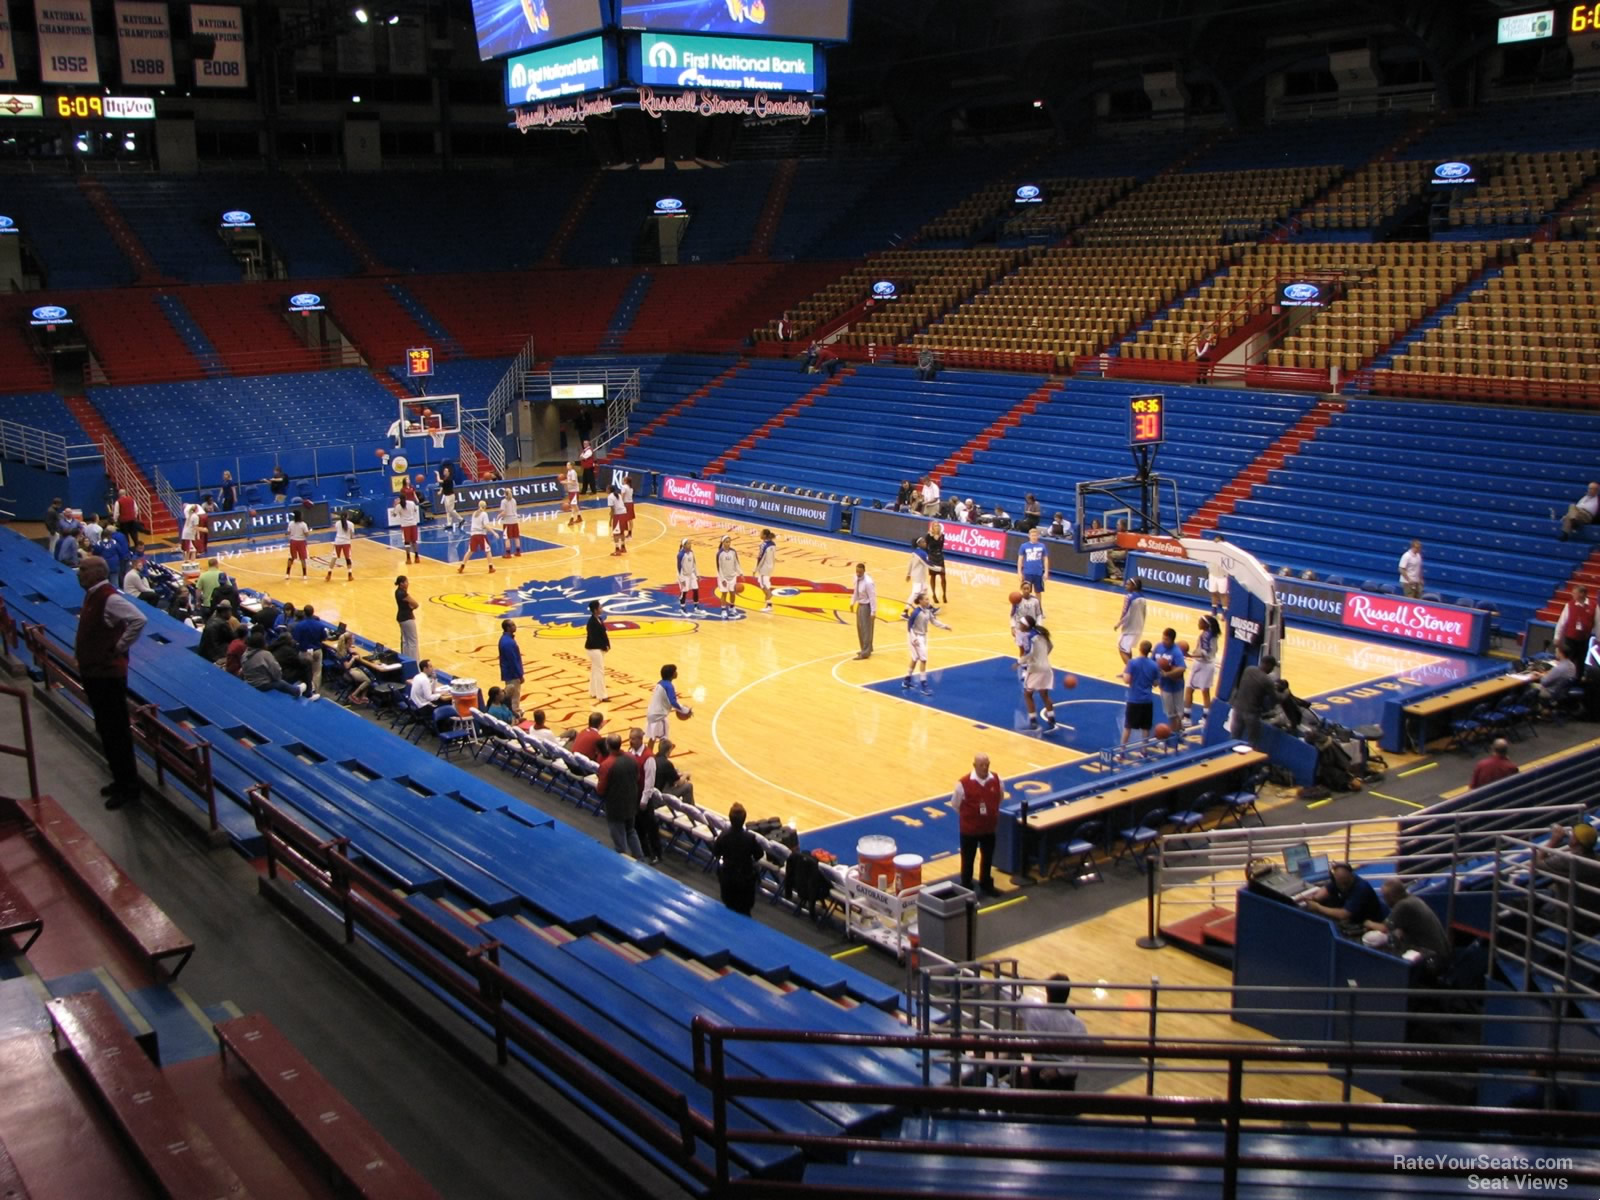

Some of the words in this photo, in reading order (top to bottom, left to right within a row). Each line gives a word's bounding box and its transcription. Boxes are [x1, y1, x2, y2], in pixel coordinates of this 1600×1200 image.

[42, 8, 88, 22] NATIONAL
[122, 15, 165, 26] NATIONAL
[198, 18, 239, 30] NATIONAL
[39, 23, 93, 36] CHAMPIONS
[119, 28, 170, 40] CHAMPIONS
[195, 32, 243, 43] MPIONS
[51, 55, 89, 73] 1952
[130, 58, 166, 75] 1988
[203, 60, 241, 77] 2008
[683, 52, 711, 69] First
[711, 53, 771, 73] National
[772, 57, 807, 75] Bank
[57, 96, 103, 117] 6:09
[576, 94, 612, 121] Candies
[637, 86, 698, 119] Russell
[699, 87, 753, 117] Stover
[754, 91, 812, 119] Candies
[410, 350, 430, 359] 49:36
[412, 358, 429, 373] 30
[1132, 399, 1159, 413] 49:36
[1135, 414, 1158, 440] 30
[469, 488, 506, 501] WHO
[512, 481, 559, 497] ENTER
[665, 478, 691, 497] Russell
[714, 493, 746, 507] WELCOME
[748, 498, 759, 509] TO
[760, 501, 781, 513] ALLEN
[783, 504, 827, 521] FIELDHOUSE
[213, 518, 243, 532] PAY
[968, 529, 1001, 551] Stover
[951, 543, 997, 559] CANDIES
[1220, 557, 1236, 571] KU
[1136, 566, 1193, 587] WELCOME
[1197, 577, 1210, 591] TO
[1275, 591, 1344, 616] ELDHOUSE
[1348, 595, 1409, 627] Russell
[1408, 606, 1463, 636] Stover
[1230, 615, 1260, 636] MUSCLE
[1382, 623, 1454, 645] CANDIES
[551, 650, 641, 686] Fieluse
[856, 884, 889, 905] GATORADE
